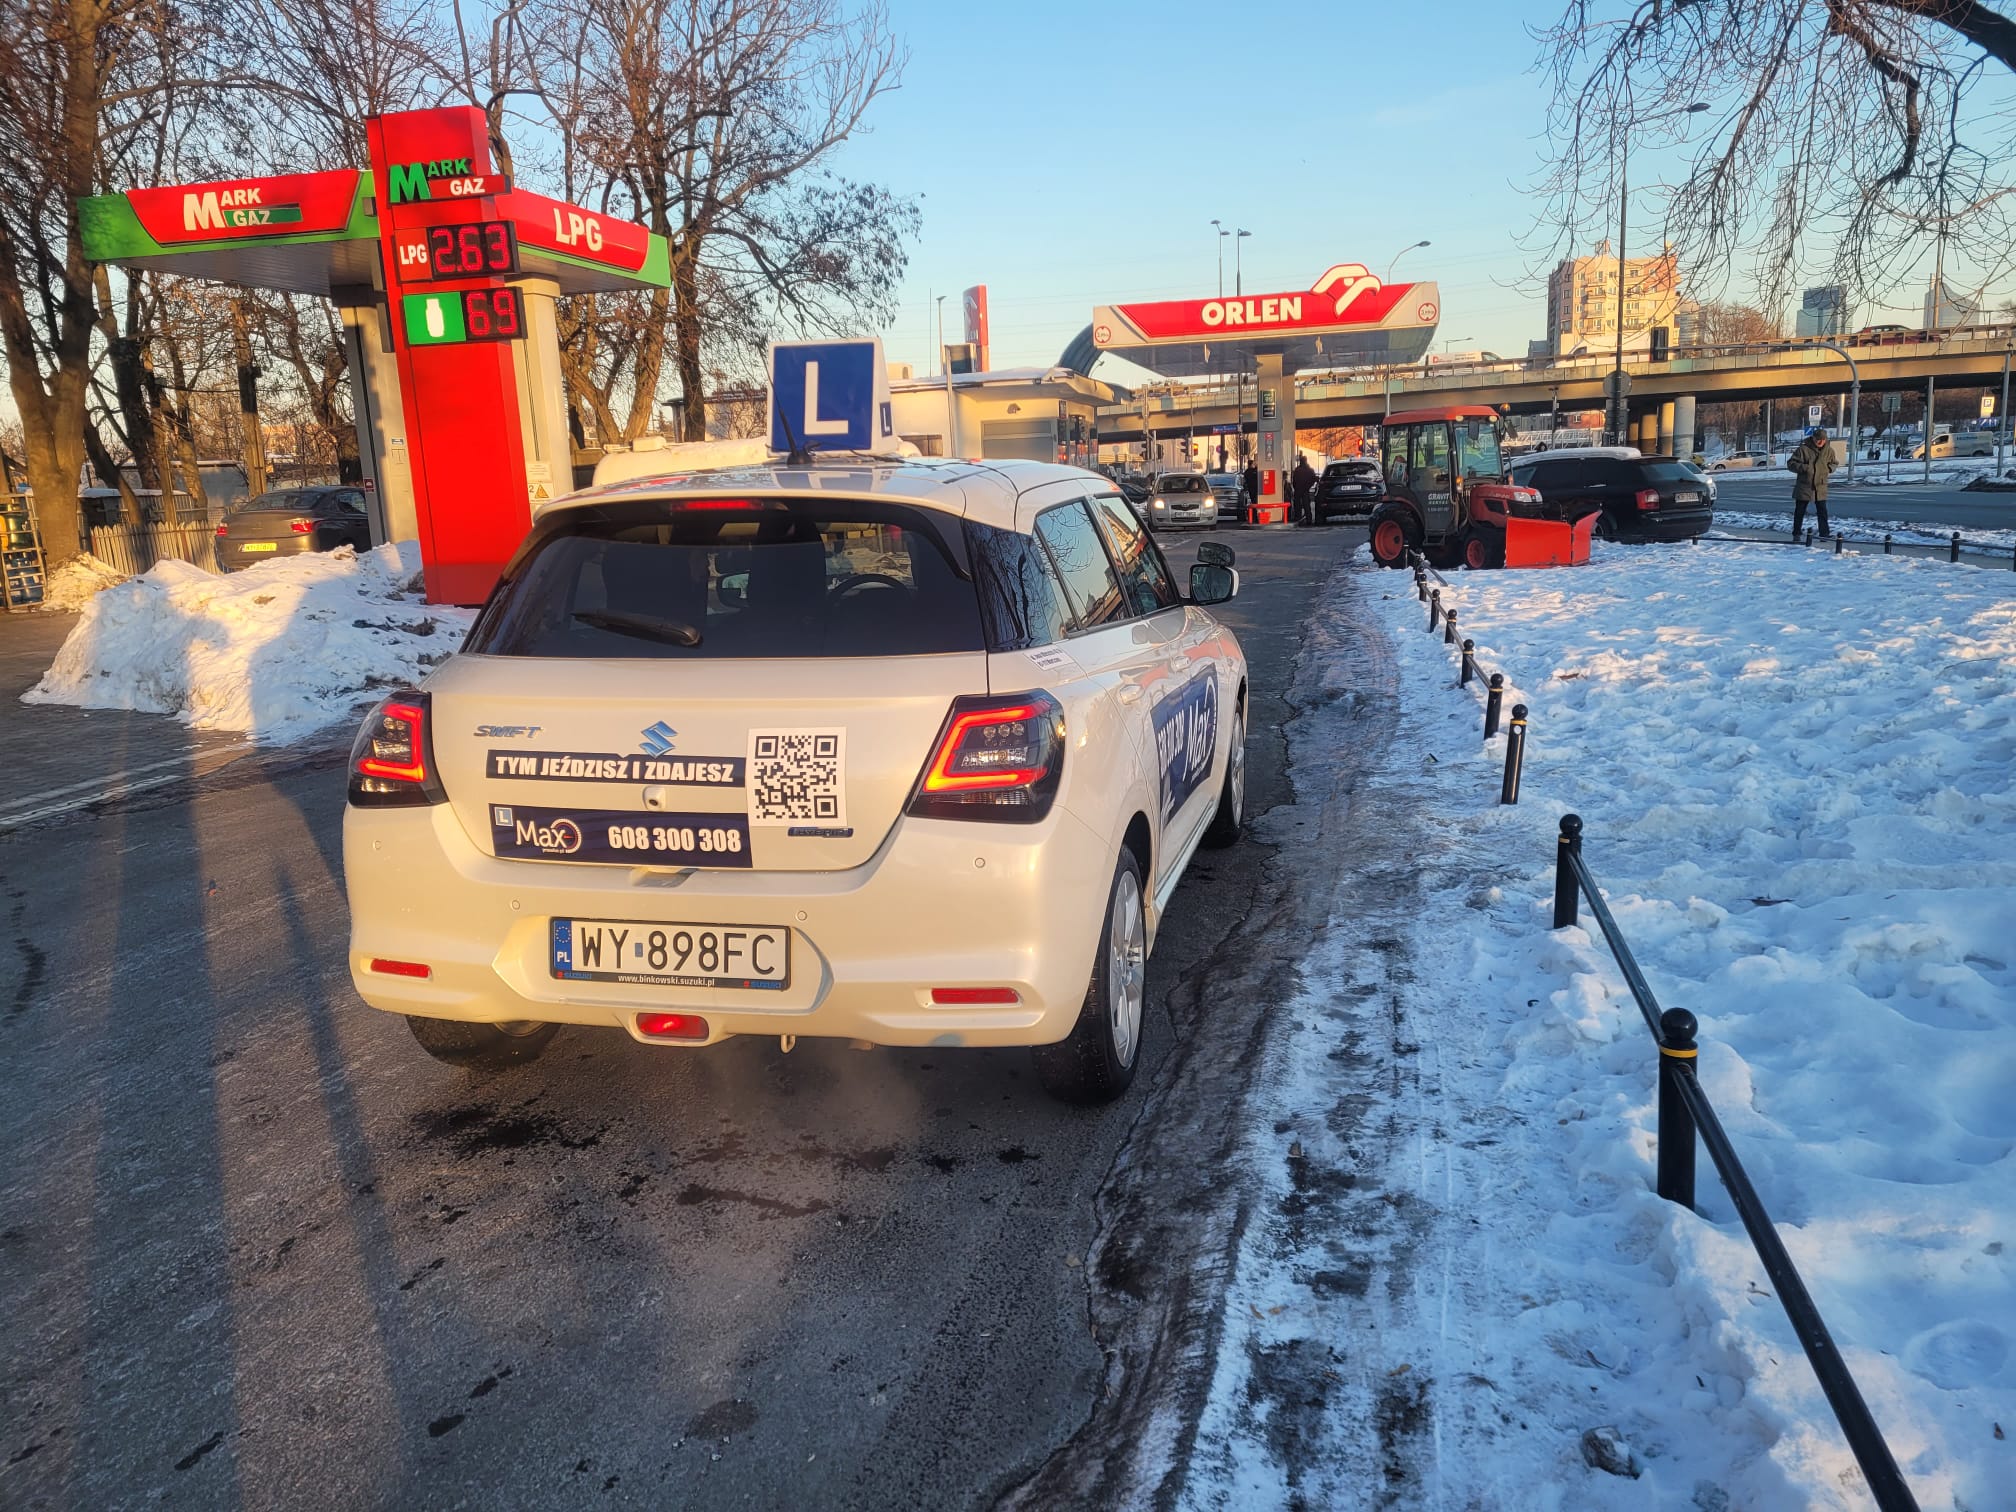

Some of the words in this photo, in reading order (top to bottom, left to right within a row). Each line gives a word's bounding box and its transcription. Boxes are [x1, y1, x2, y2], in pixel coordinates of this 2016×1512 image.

[389, 158, 469, 203] MARK
[450, 178, 485, 195] GAZ
[184, 188, 262, 231] MARK
[233, 210, 273, 226] GAZ
[553, 208, 603, 252] LPG
[400, 244, 427, 264] LPG
[432, 223, 510, 272] 2.63
[466, 289, 517, 336] 69
[1202, 297, 1302, 326] ORLEN
[804, 361, 848, 435] L
[883, 407, 890, 432] L
[473, 725, 543, 738] SWIFT
[1182, 699, 1210, 782] Max
[496, 757, 537, 776] TYM
[541, 755, 628, 779] JEŹDZISZ
[632, 761, 640, 779] I
[644, 761, 734, 782] ZDAJESZ
[499, 810, 509, 823] L
[516, 820, 568, 849] Max
[608, 826, 649, 850] 608
[652, 827, 695, 851] 300
[698, 828, 741, 852] 308
[556, 951, 571, 963] PL
[581, 927, 629, 969] WY
[648, 930, 775, 975] 898FC
[618, 975, 715, 987] www.binkowski.suzuki.pl
